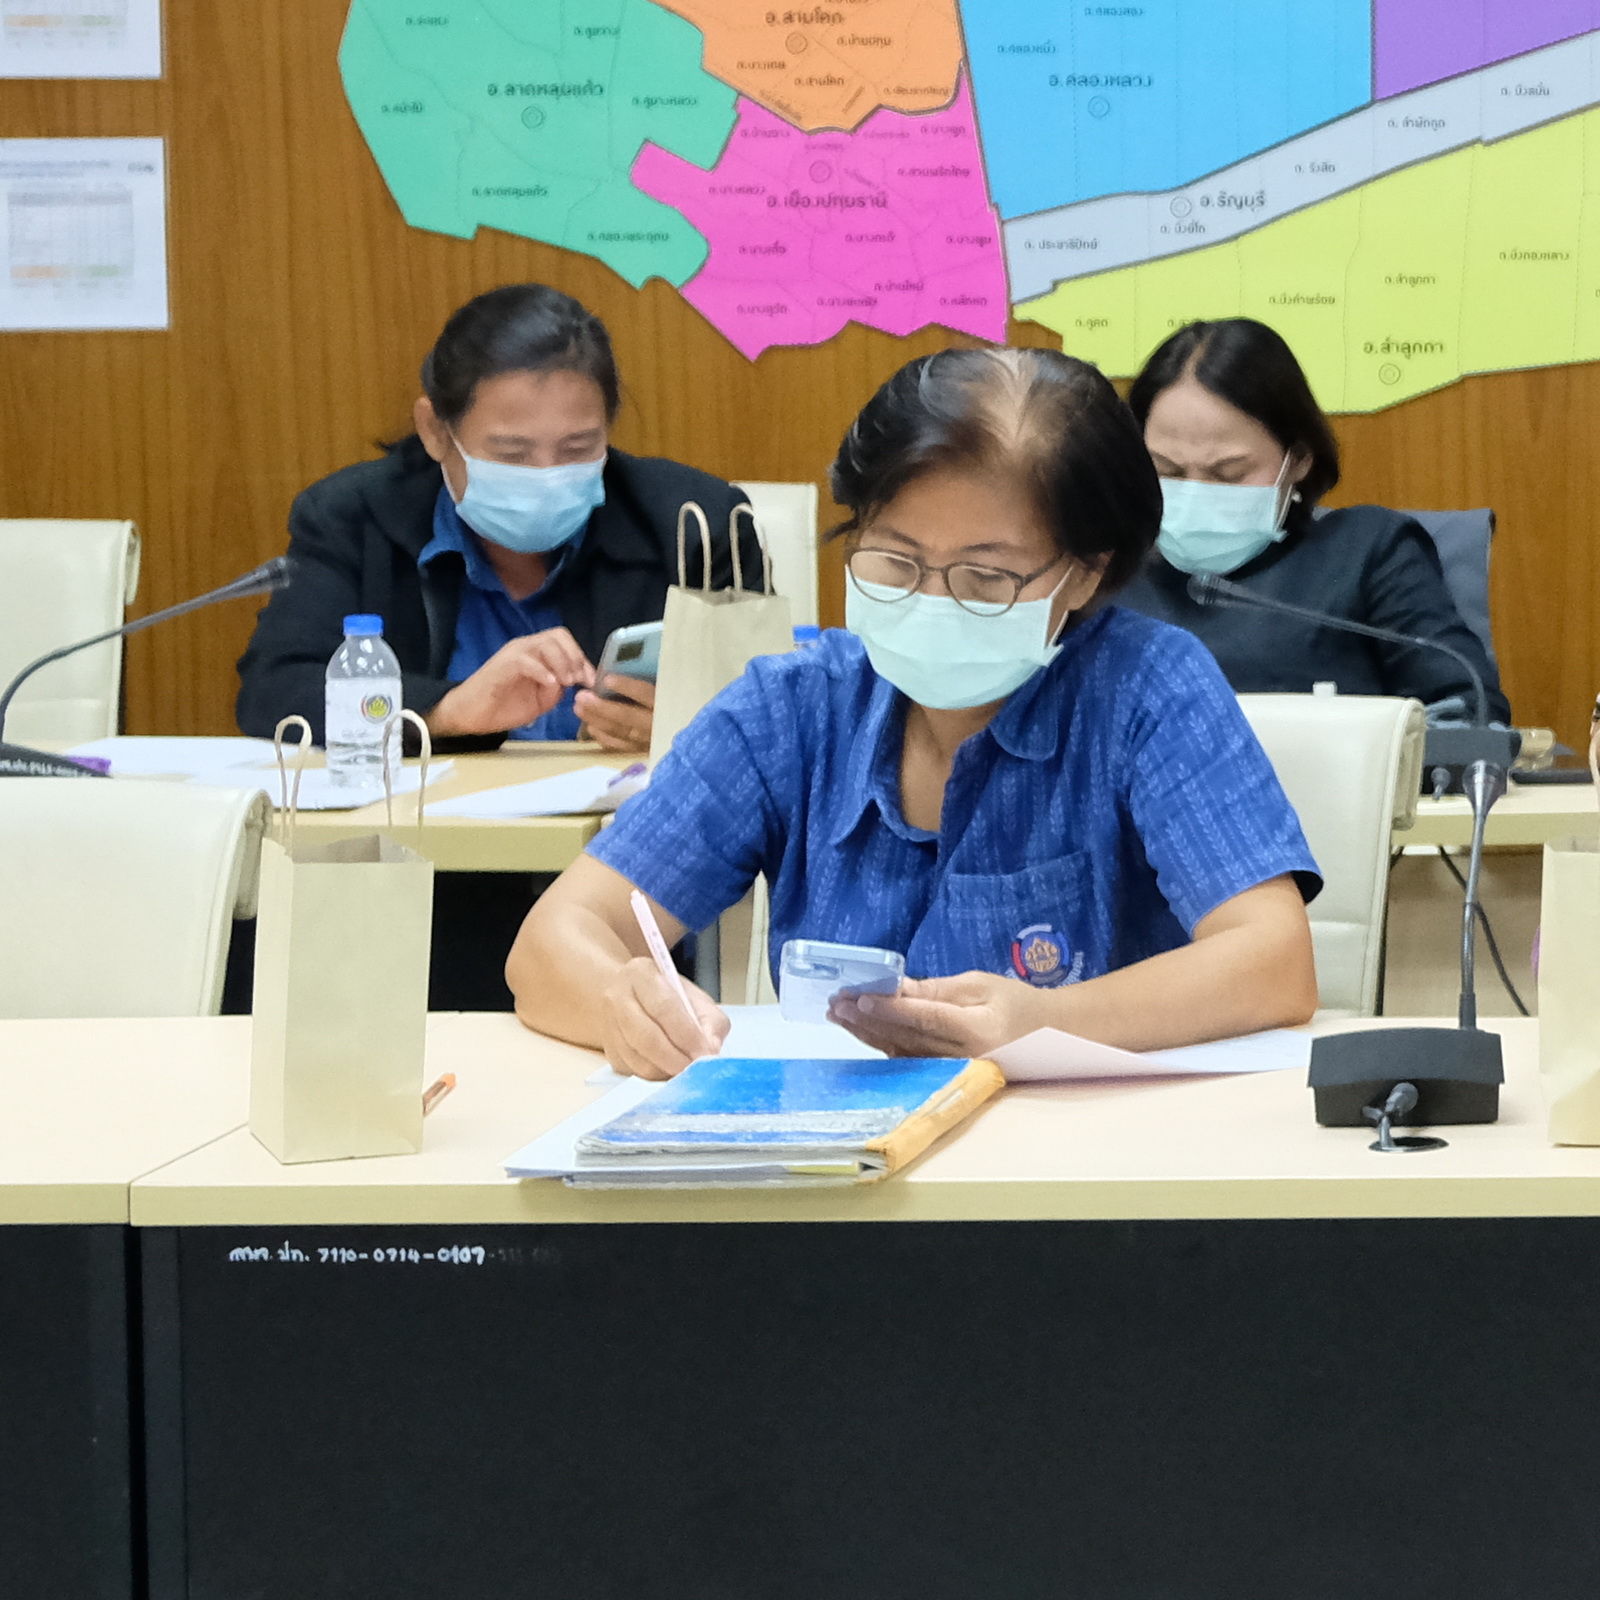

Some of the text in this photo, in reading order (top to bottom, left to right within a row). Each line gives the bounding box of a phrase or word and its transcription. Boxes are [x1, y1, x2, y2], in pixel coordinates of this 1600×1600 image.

[765, 8, 844, 25] อ.สามโคก
[1049, 74, 1153, 88] อ.คลองหลวง
[1200, 191, 1266, 212] อ.ธัญบุรี
[1363, 336, 1445, 359] อ.ลำลูกกา
